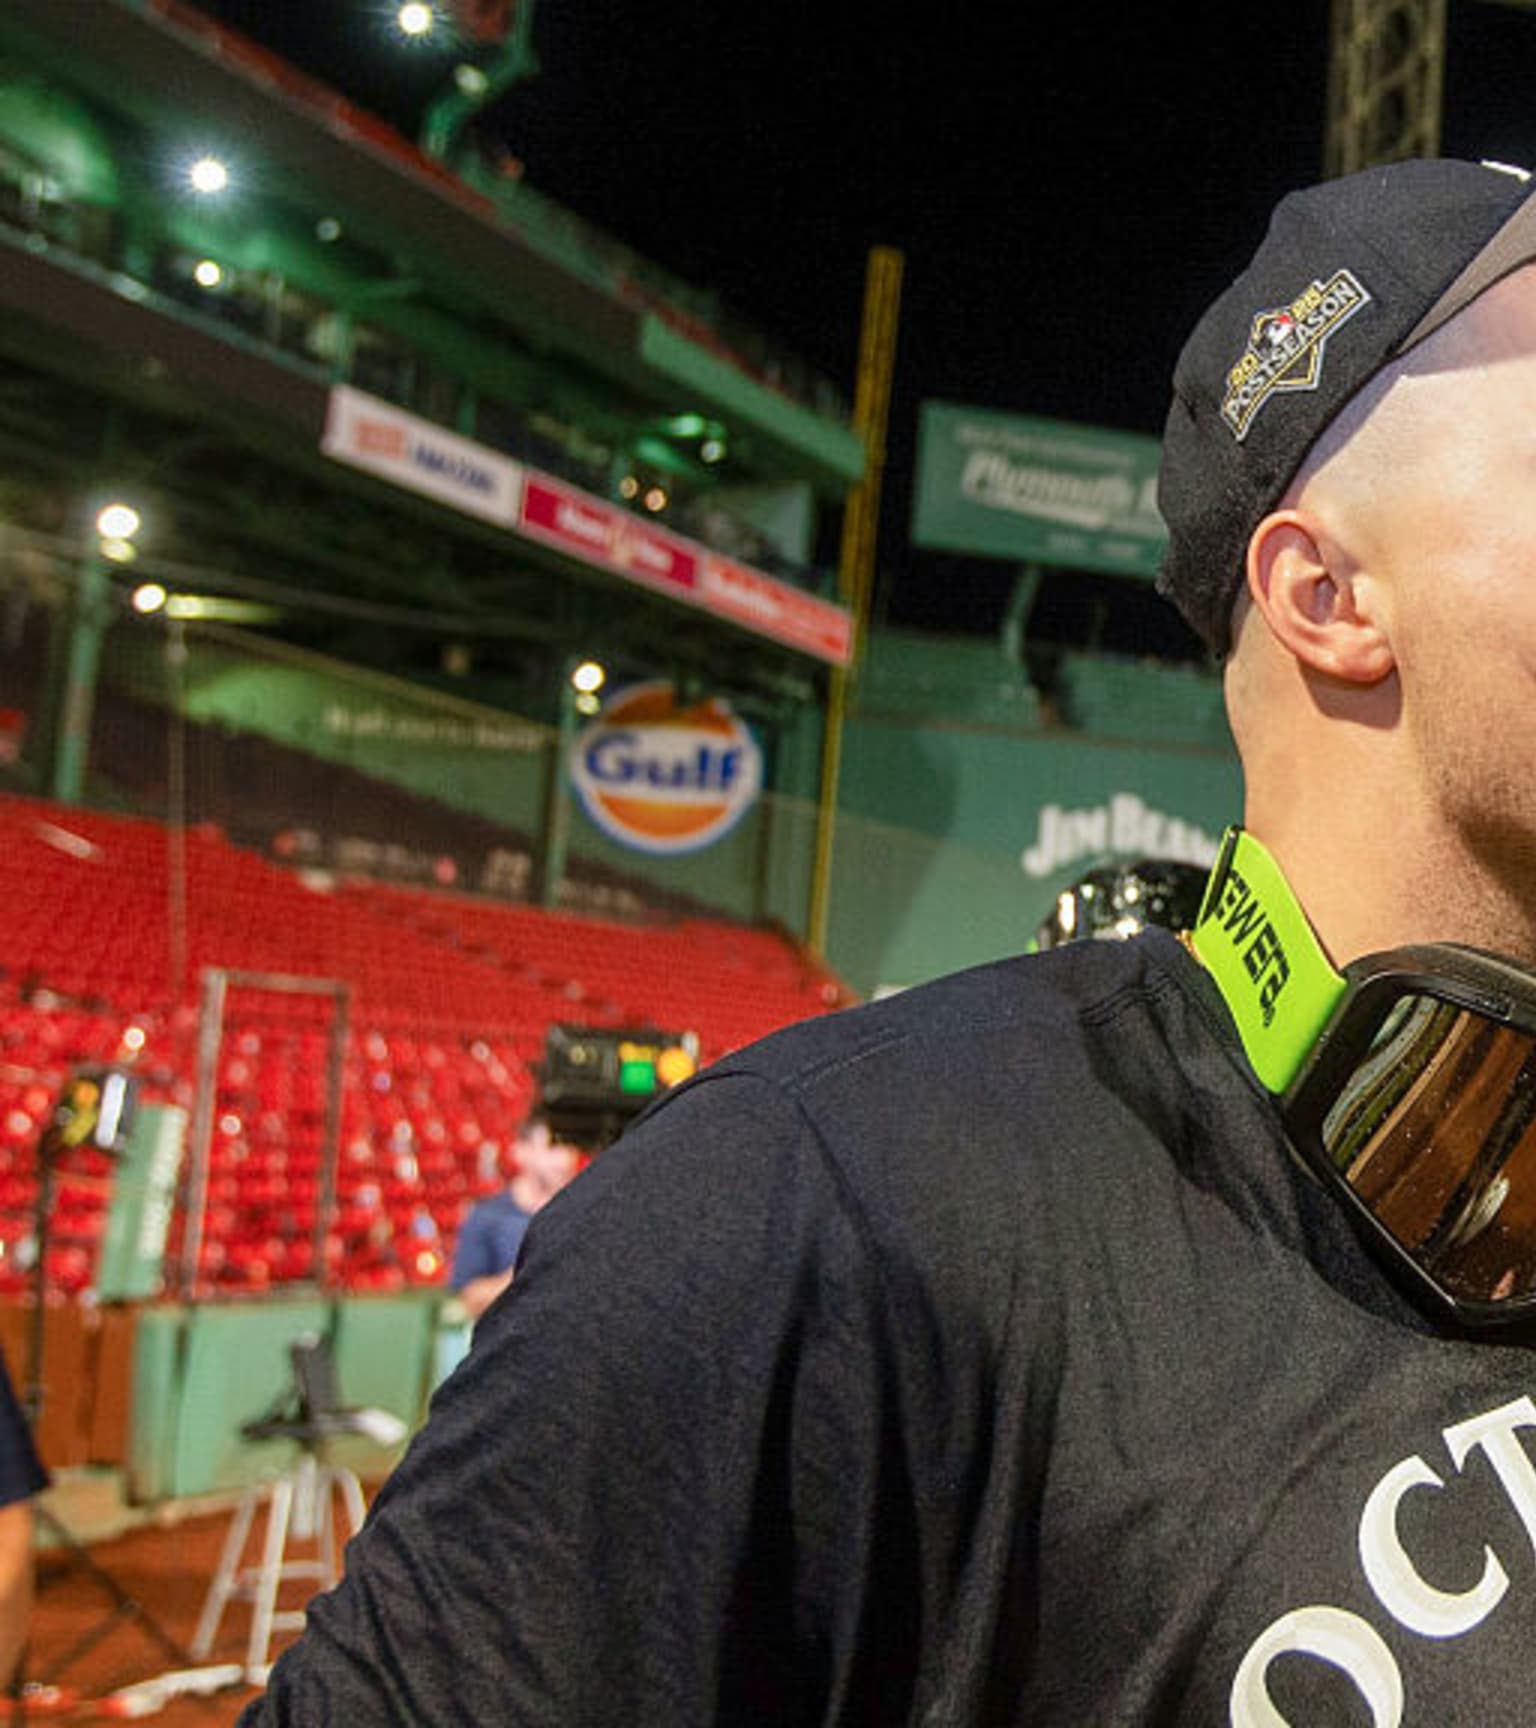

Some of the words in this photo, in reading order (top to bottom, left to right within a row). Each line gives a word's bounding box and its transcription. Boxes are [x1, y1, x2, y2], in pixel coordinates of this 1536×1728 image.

[1225, 280, 1356, 425] POSTSEASON
[585, 730, 742, 791] Gulf
[1022, 804, 1111, 877] JIM
